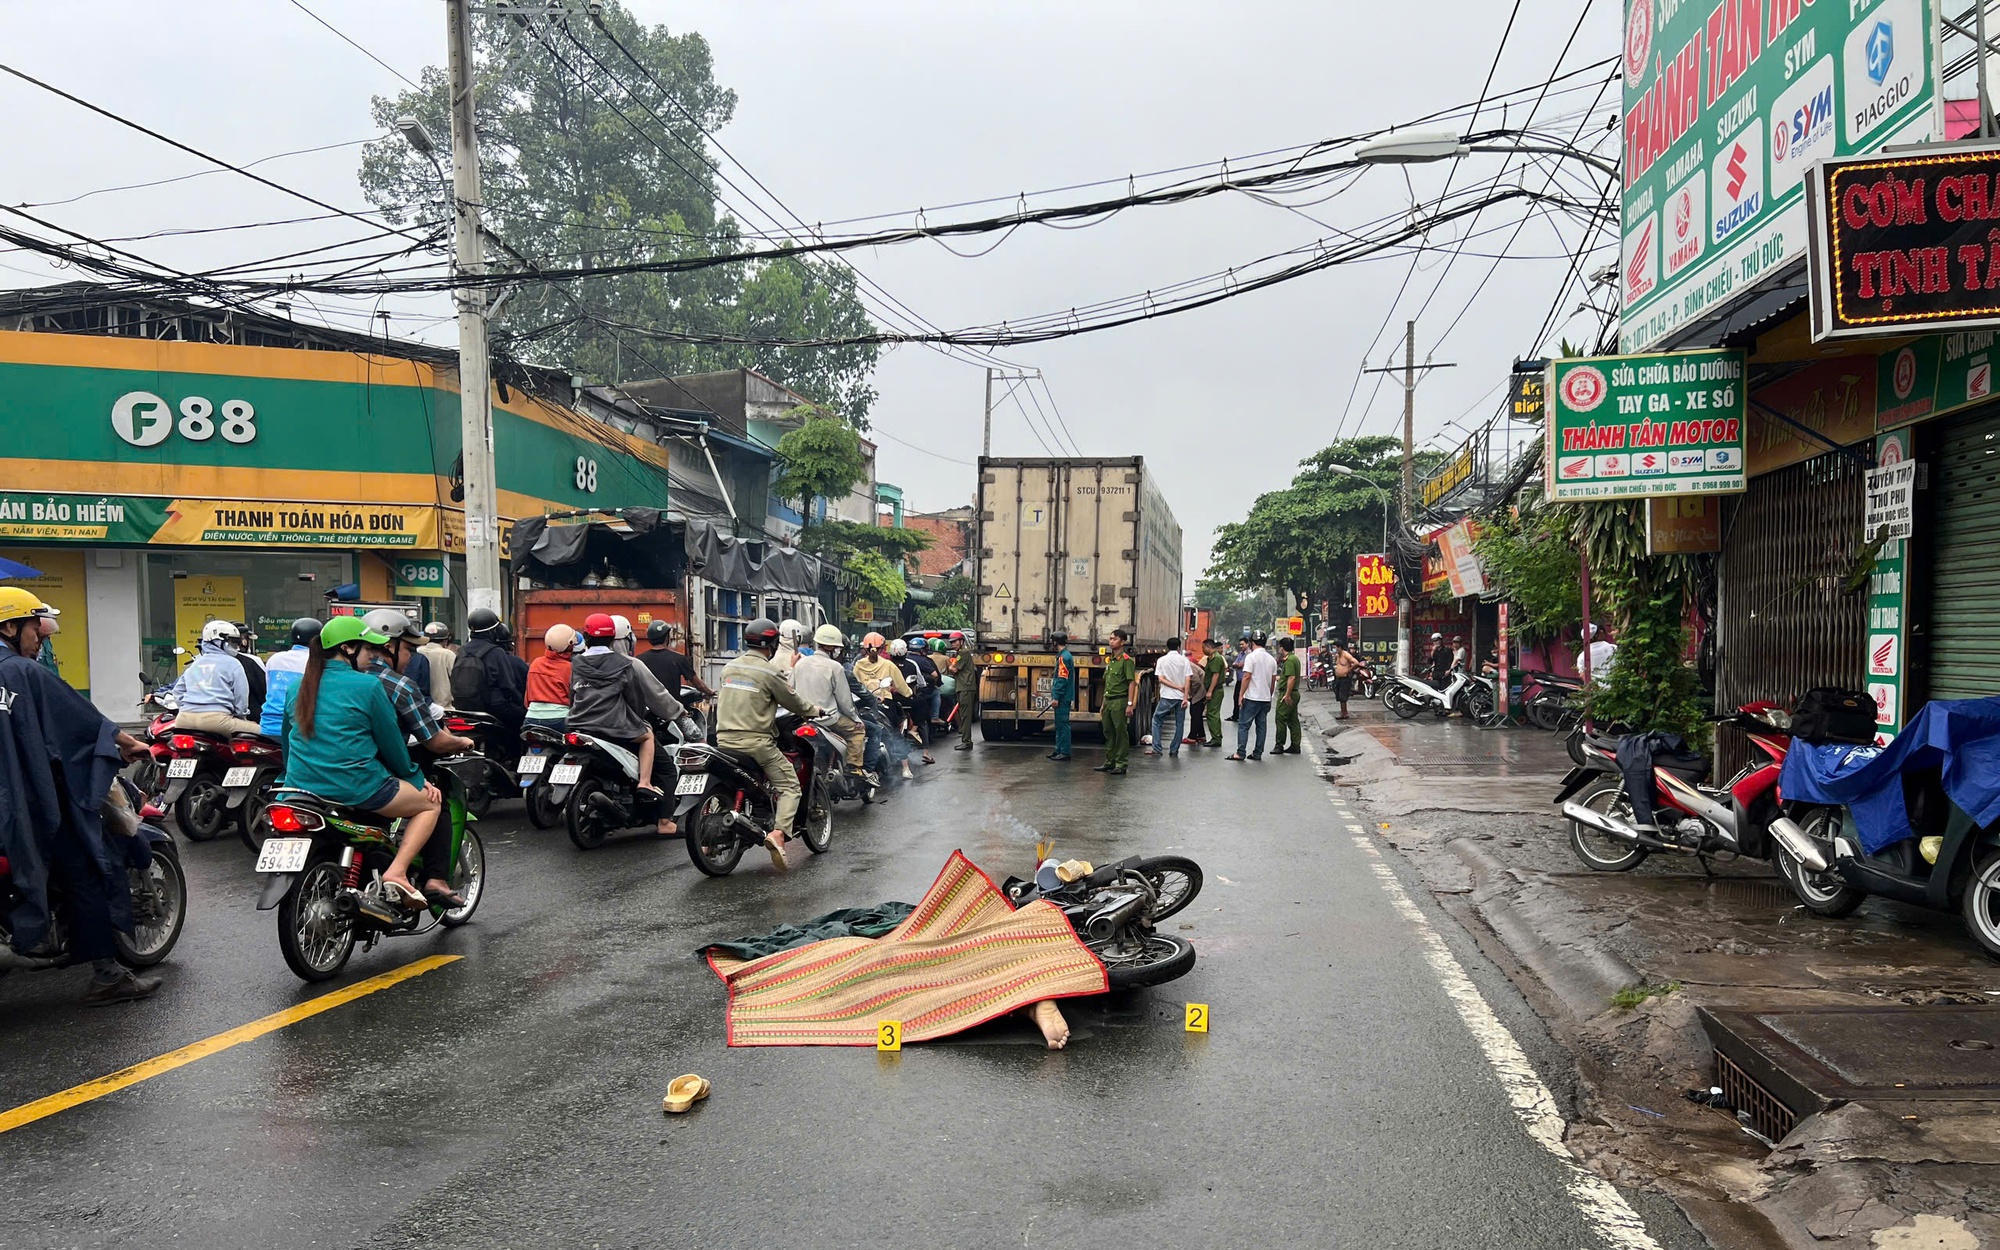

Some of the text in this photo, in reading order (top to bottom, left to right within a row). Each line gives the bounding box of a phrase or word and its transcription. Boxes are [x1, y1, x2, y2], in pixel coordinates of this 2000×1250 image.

[1784, 28, 1815, 81] SYM
[1716, 85, 1757, 145] SUZUKI
[1791, 84, 1832, 144] SYM
[1855, 76, 1909, 133] PIAGGIO
[1791, 121, 1833, 158] Engine of Life
[1665, 139, 1703, 191] YAMAHA
[1626, 186, 1654, 227] HONDA
[1716, 191, 1759, 239] SUZUKI
[1843, 172, 1927, 229] CƠM
[1669, 237, 1699, 273] YAMAHA
[1627, 277, 1653, 305] HONDA
[1633, 328, 1648, 347] 1071
[1650, 312, 1666, 338] TL43
[1684, 289, 1704, 318] BÌNH
[1741, 241, 1759, 282] THỦ
[1763, 233, 1784, 269] ĐỨC
[1852, 247, 1950, 311] TỊNH
[1611, 357, 1740, 387] SỬA CHỮA BẢO DƯỠNG
[1617, 395, 1644, 414] TAY
[1648, 394, 1670, 413] GA
[1686, 391, 1707, 410] XE
[1712, 382, 1735, 408] SỐ
[111, 391, 257, 446] F88
[1563, 417, 1740, 451] THÀNH TÂN MOTOR
[574, 455, 598, 494] 88
[1681, 456, 1703, 464] SYM
[1077, 487, 1096, 495] STCU
[1101, 487, 1125, 495] 937211
[1570, 488, 1584, 496] 1071
[1585, 487, 1599, 496] TL43
[1613, 484, 1628, 494] BÌNH
[1702, 481, 1717, 489] 0968
[1890, 488, 1906, 506] PHỤ
[32, 498, 70, 522] BẢO
[76, 498, 124, 523] HIỂM
[214, 509, 404, 531] THANH TOÁN HÓA ĐƠN
[63, 528, 77, 536] TAI
[204, 531, 226, 541] ĐIỆN
[227, 531, 256, 542] NƯỚC,
[258, 532, 279, 542] VIỄN
[281, 533, 311, 542] THÔNG
[319, 533, 336, 543] THẺ
[337, 535, 358, 544] ĐIỆN
[389, 536, 413, 544] GAME
[401, 564, 439, 582] F88
[1872, 666, 1894, 674] HONDA
[676, 783, 702, 794] 069.61
[259, 856, 301, 870] 594.34
[268, 842, 303, 855] 59-X3
[1189, 1007, 1203, 1029] 2
[880, 1025, 896, 1047] 3
